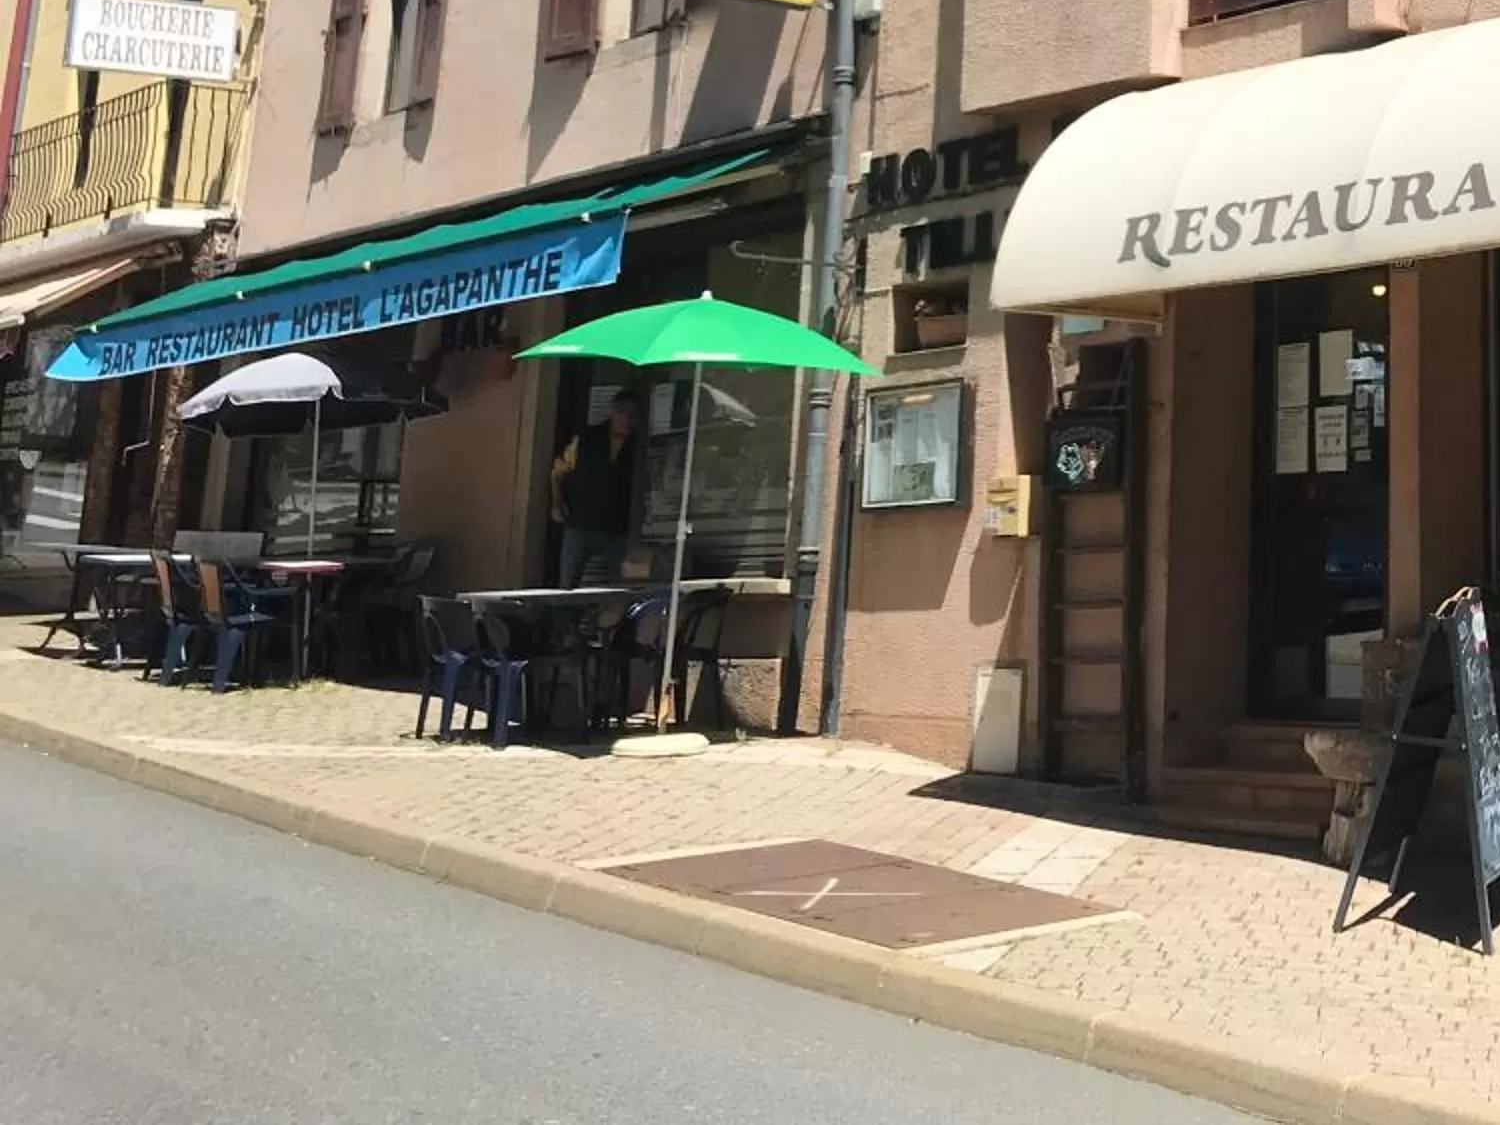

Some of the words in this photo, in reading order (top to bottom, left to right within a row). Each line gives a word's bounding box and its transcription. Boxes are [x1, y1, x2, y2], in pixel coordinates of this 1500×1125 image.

[101, 0, 216, 39] BOUCHERIE
[81, 30, 225, 73] CHARCUTERIE
[100, 345, 136, 375] BAR
[146, 313, 280, 364] RESTAURANT
[290, 298, 364, 339] HOTEL
[379, 250, 563, 323] L'AGAPANTHE
